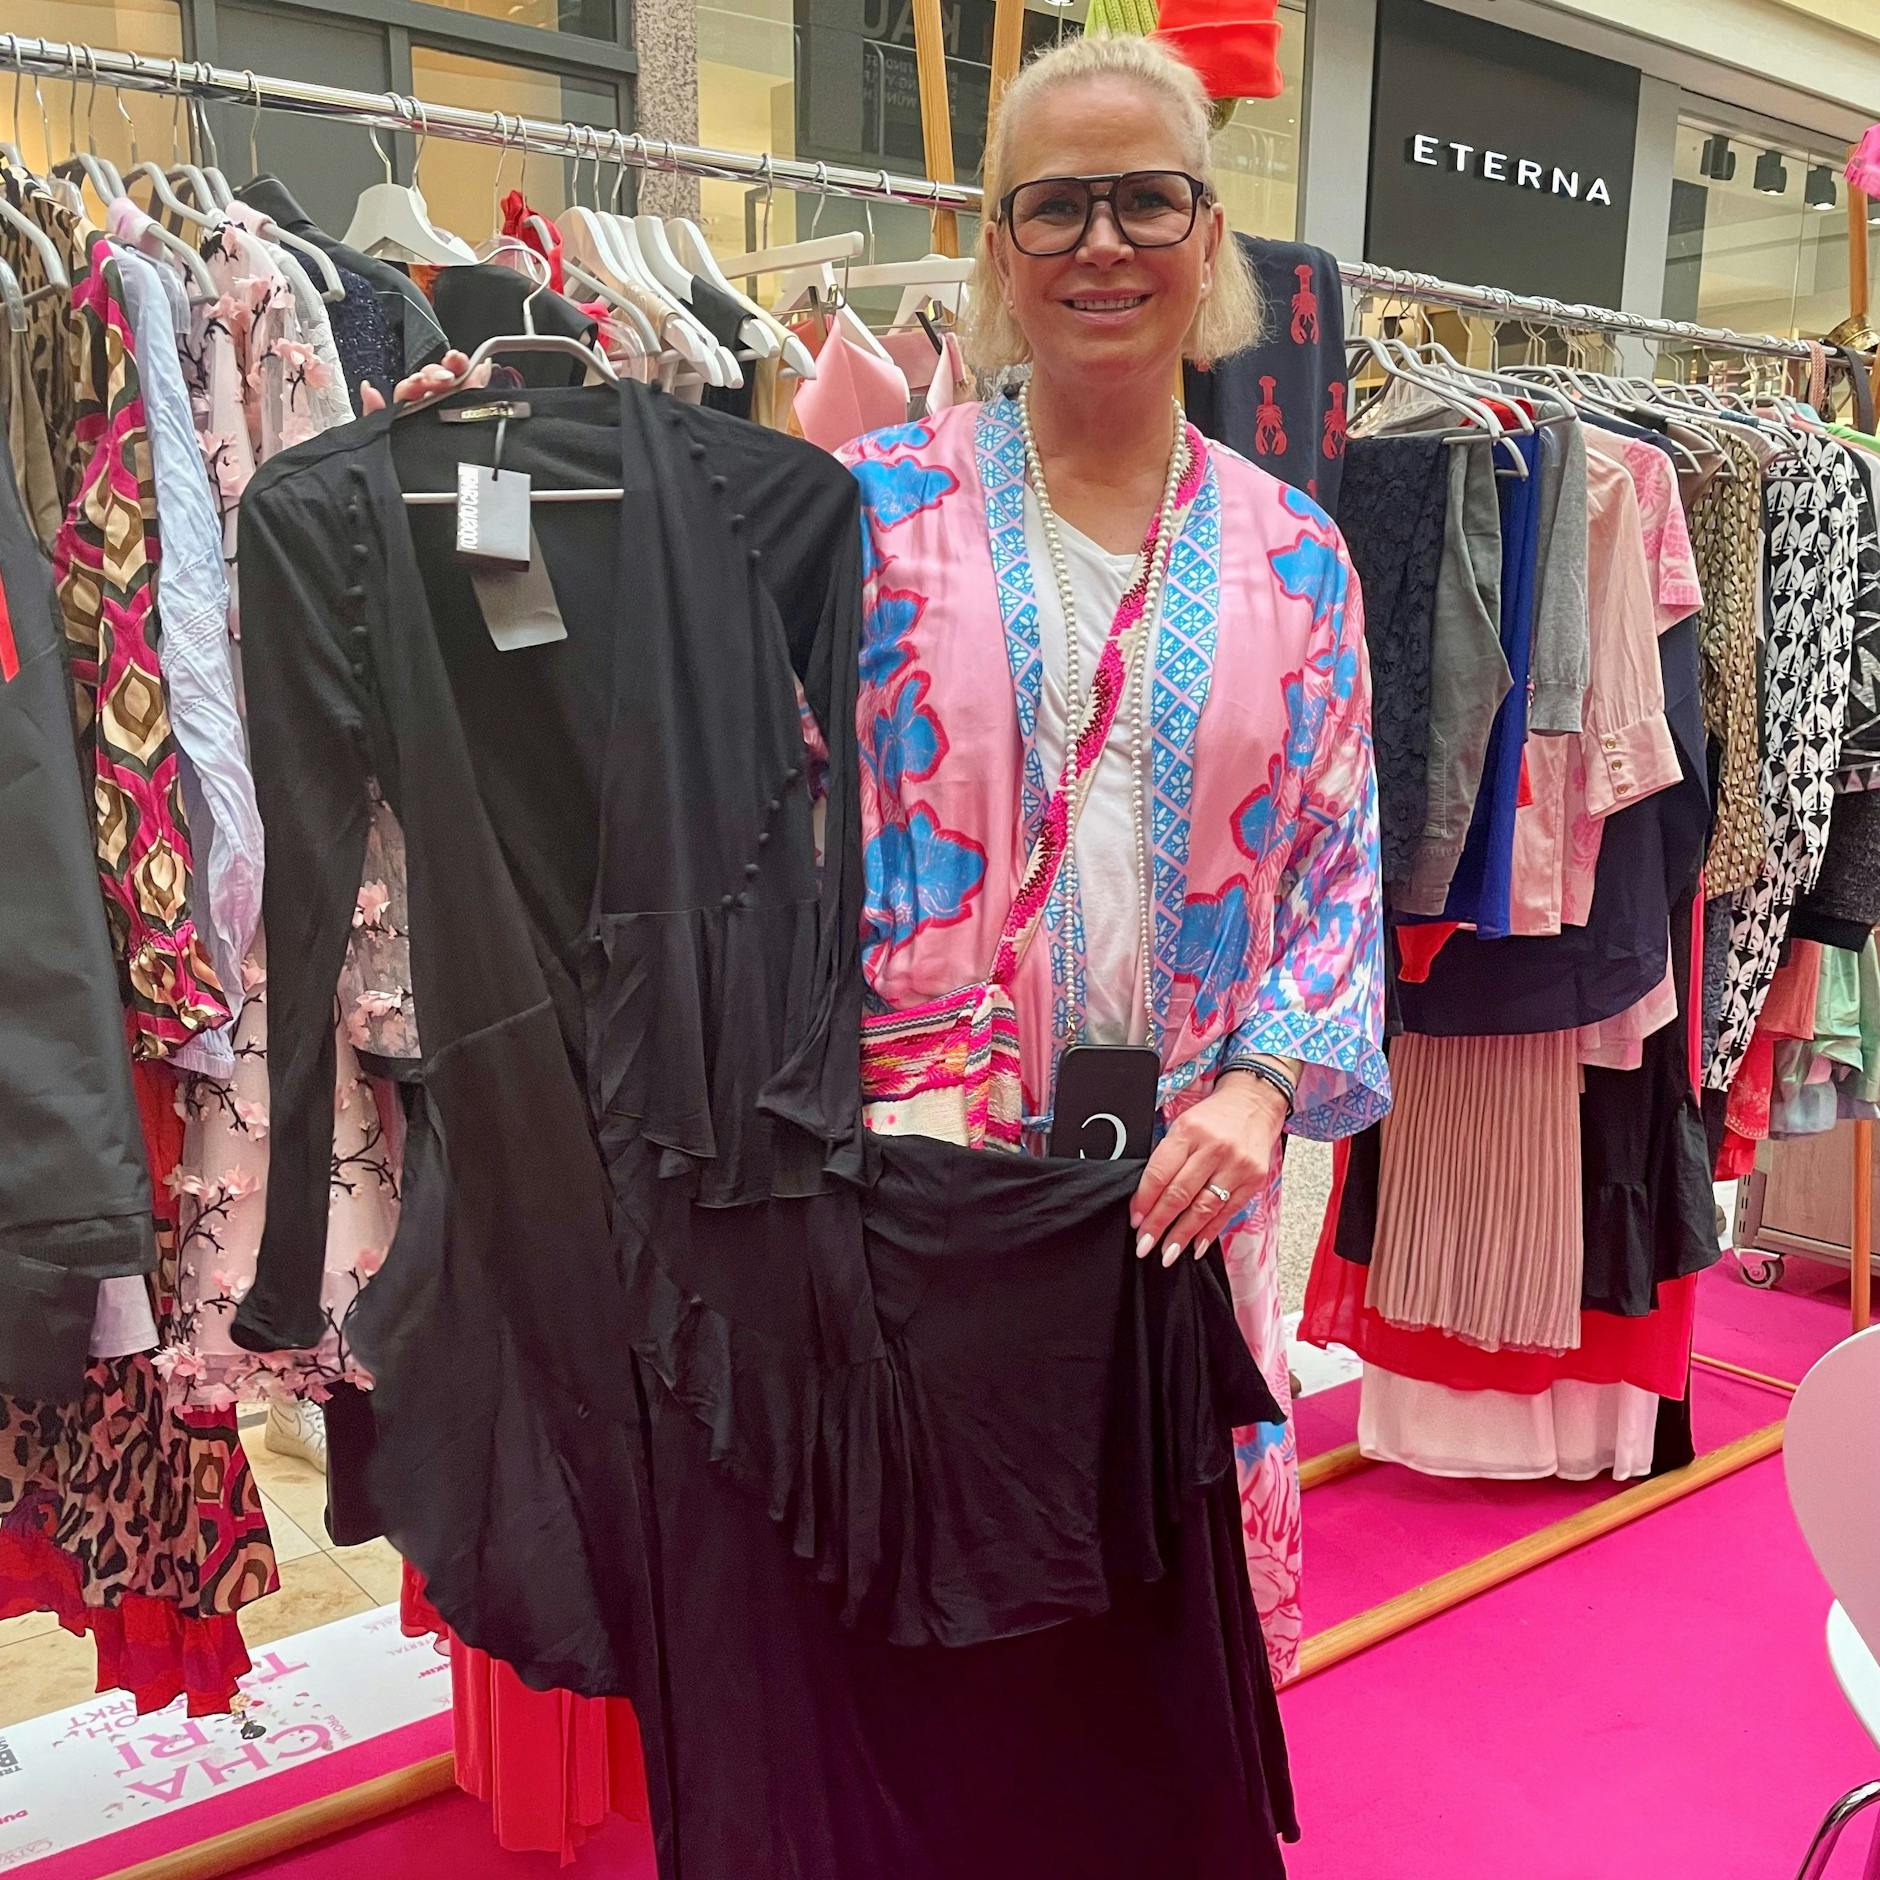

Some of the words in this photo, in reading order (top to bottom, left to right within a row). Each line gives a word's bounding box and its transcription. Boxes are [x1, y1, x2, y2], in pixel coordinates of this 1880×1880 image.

[1413, 134, 1611, 206] ETERNA
[113, 1720, 212, 1778] RI
[324, 1714, 352, 1741] PROMI
[124, 1724, 330, 1803] CHA
